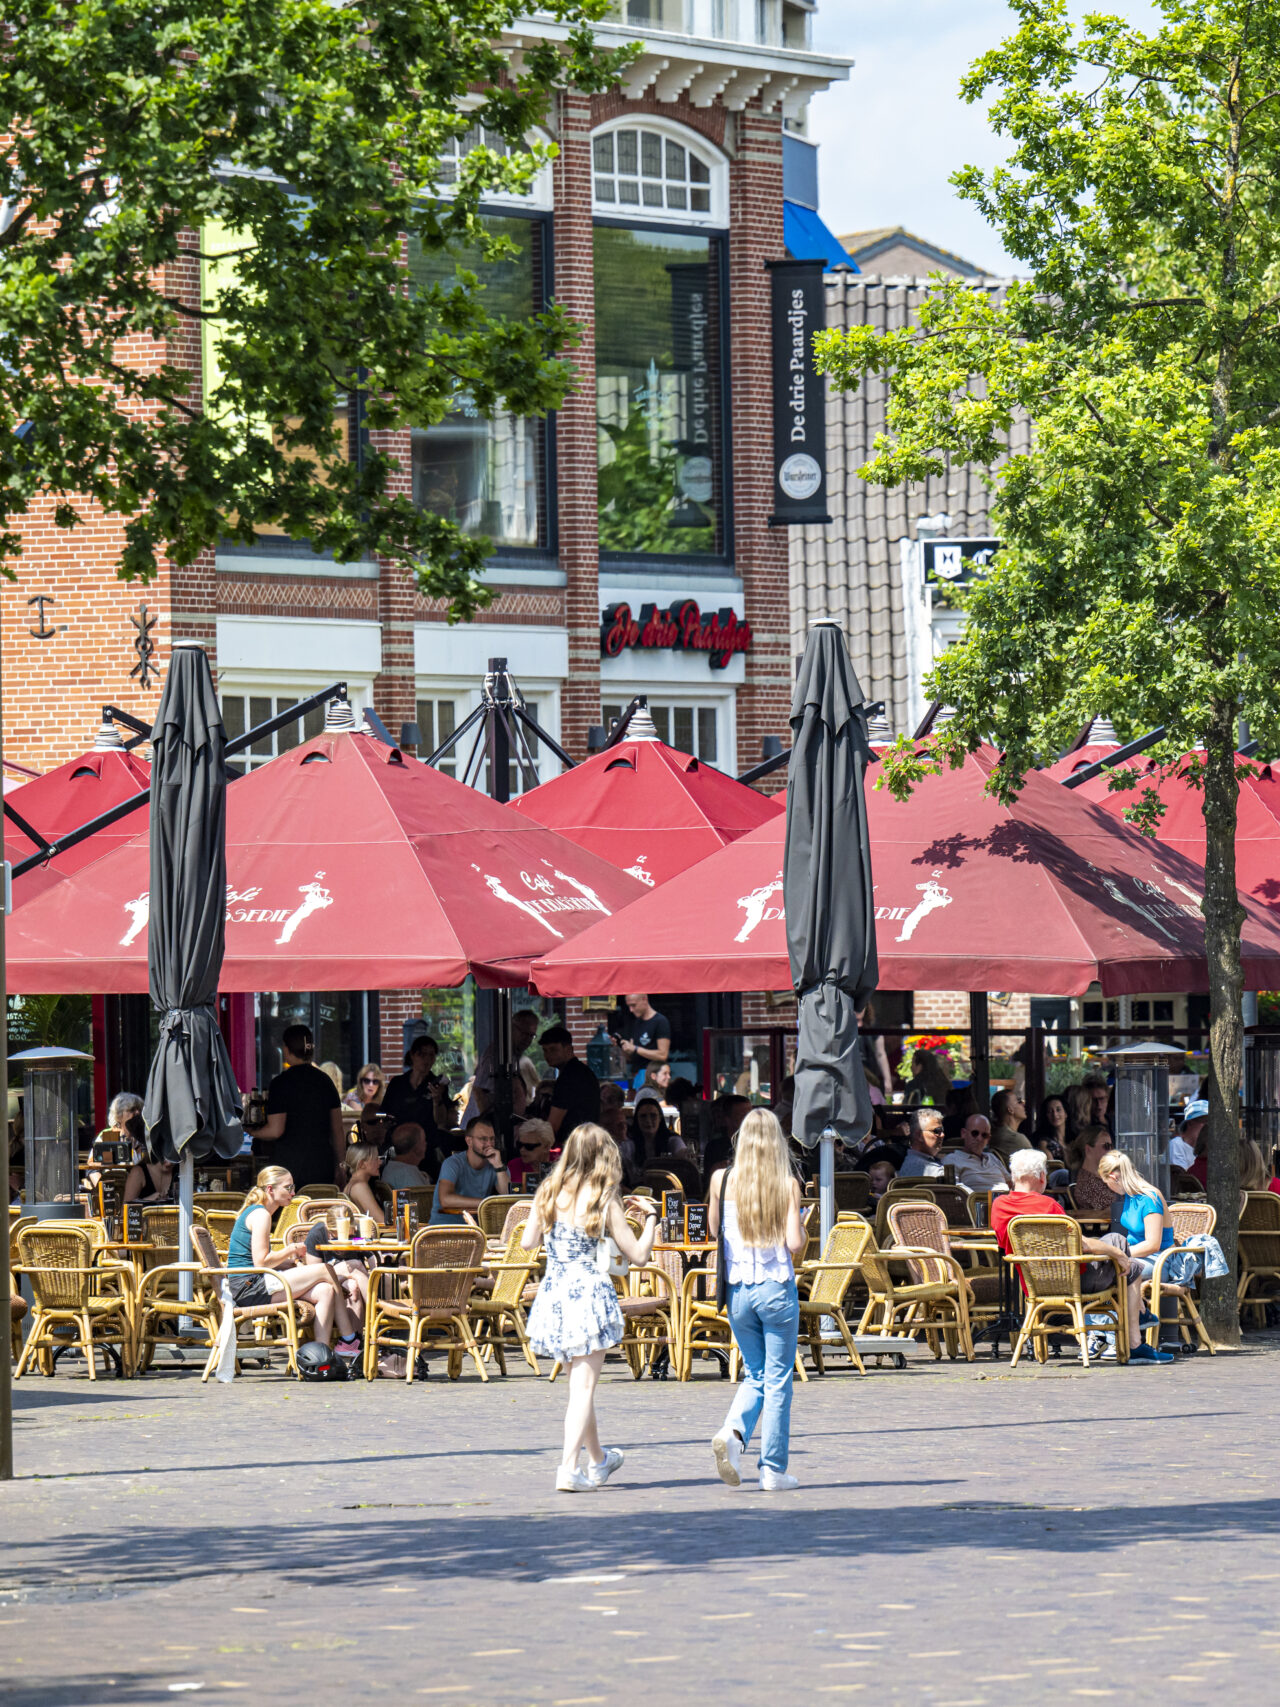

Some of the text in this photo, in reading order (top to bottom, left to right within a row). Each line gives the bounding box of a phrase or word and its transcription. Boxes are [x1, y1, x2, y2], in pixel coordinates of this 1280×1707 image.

[788, 289, 808, 442] De drie Paardjes
